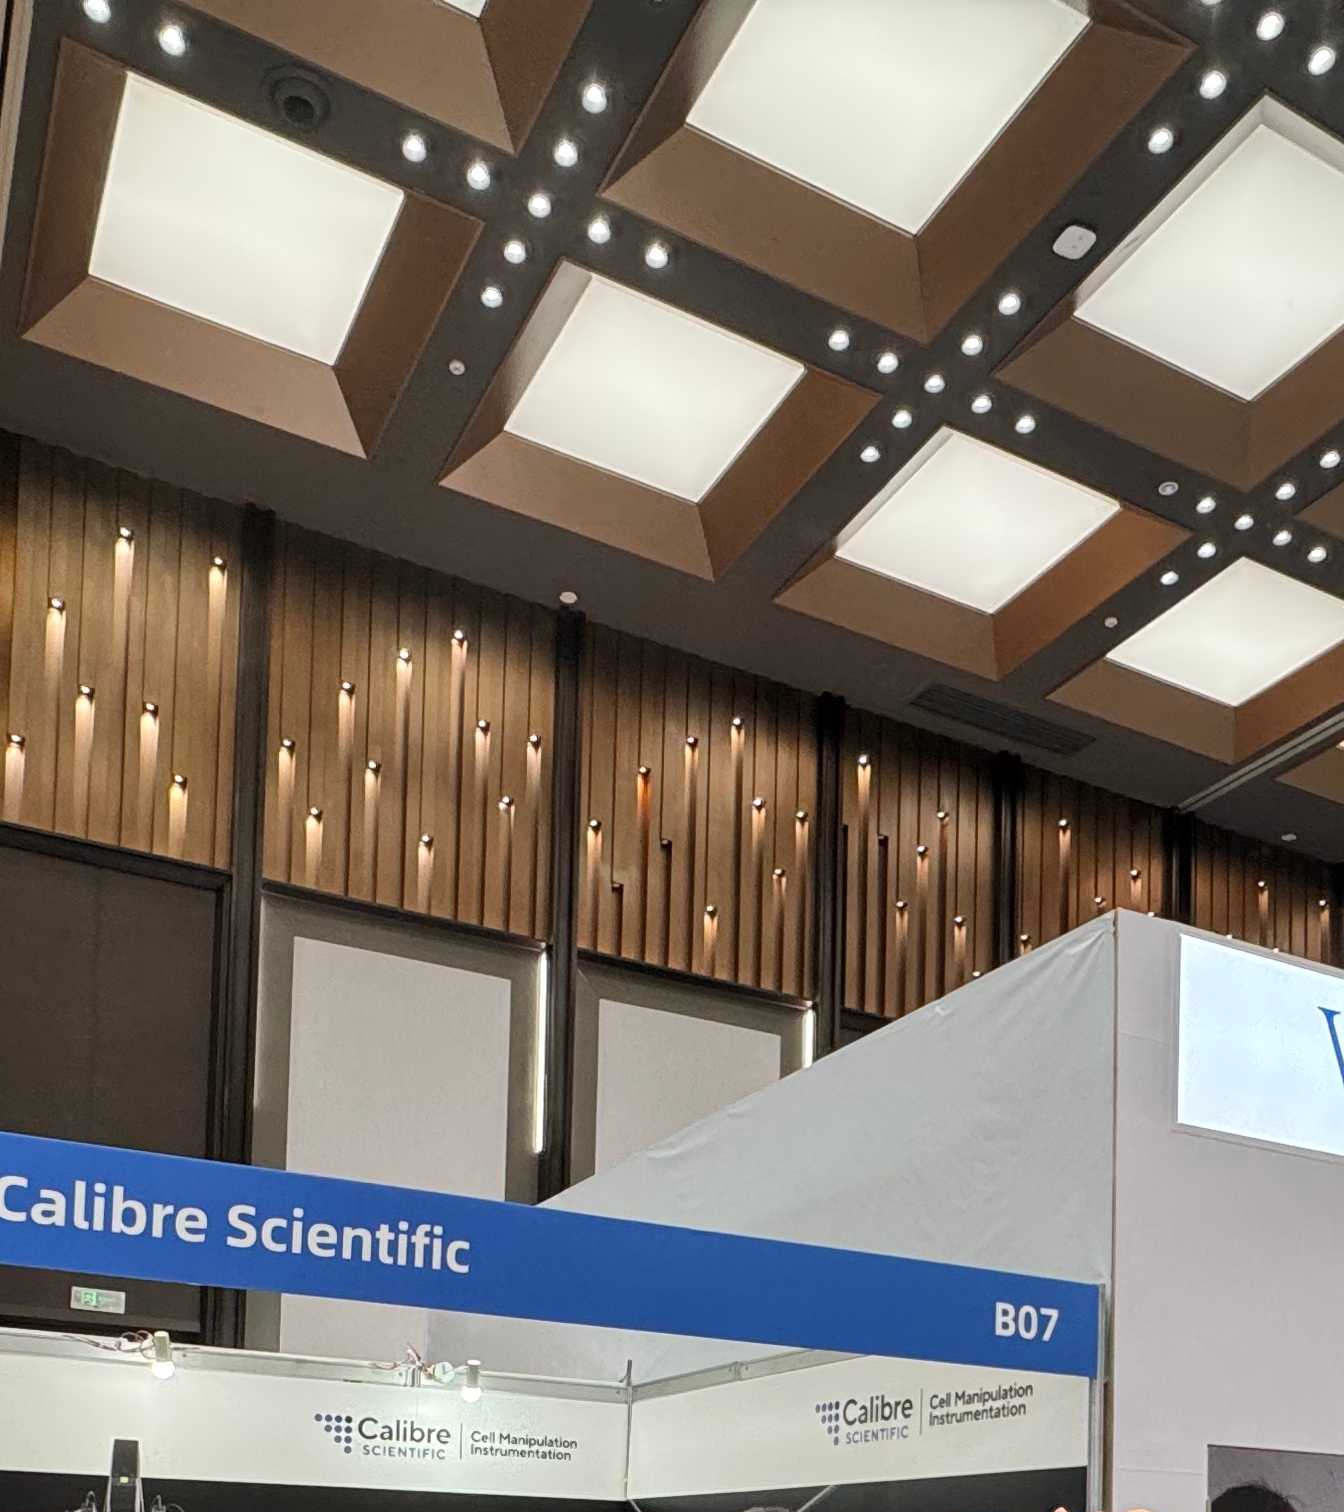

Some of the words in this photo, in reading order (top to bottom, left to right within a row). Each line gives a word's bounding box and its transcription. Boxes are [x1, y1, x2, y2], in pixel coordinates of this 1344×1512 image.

[225, 1203, 472, 1275] Scientific
[994, 1301, 1060, 1342] B07
[929, 1391, 952, 1410] Cell
[954, 1382, 1034, 1406] Manipulation
[842, 1394, 914, 1426] Calibre
[928, 1401, 1027, 1427] Instrumentation
[357, 1416, 452, 1445] Calibre
[470, 1430, 496, 1444] Cell
[498, 1433, 578, 1450] Manipulation
[845, 1425, 909, 1445] SCIENTIFIC
[362, 1444, 446, 1460] SCIENTIFIC
[470, 1444, 572, 1461] Instrumentation
